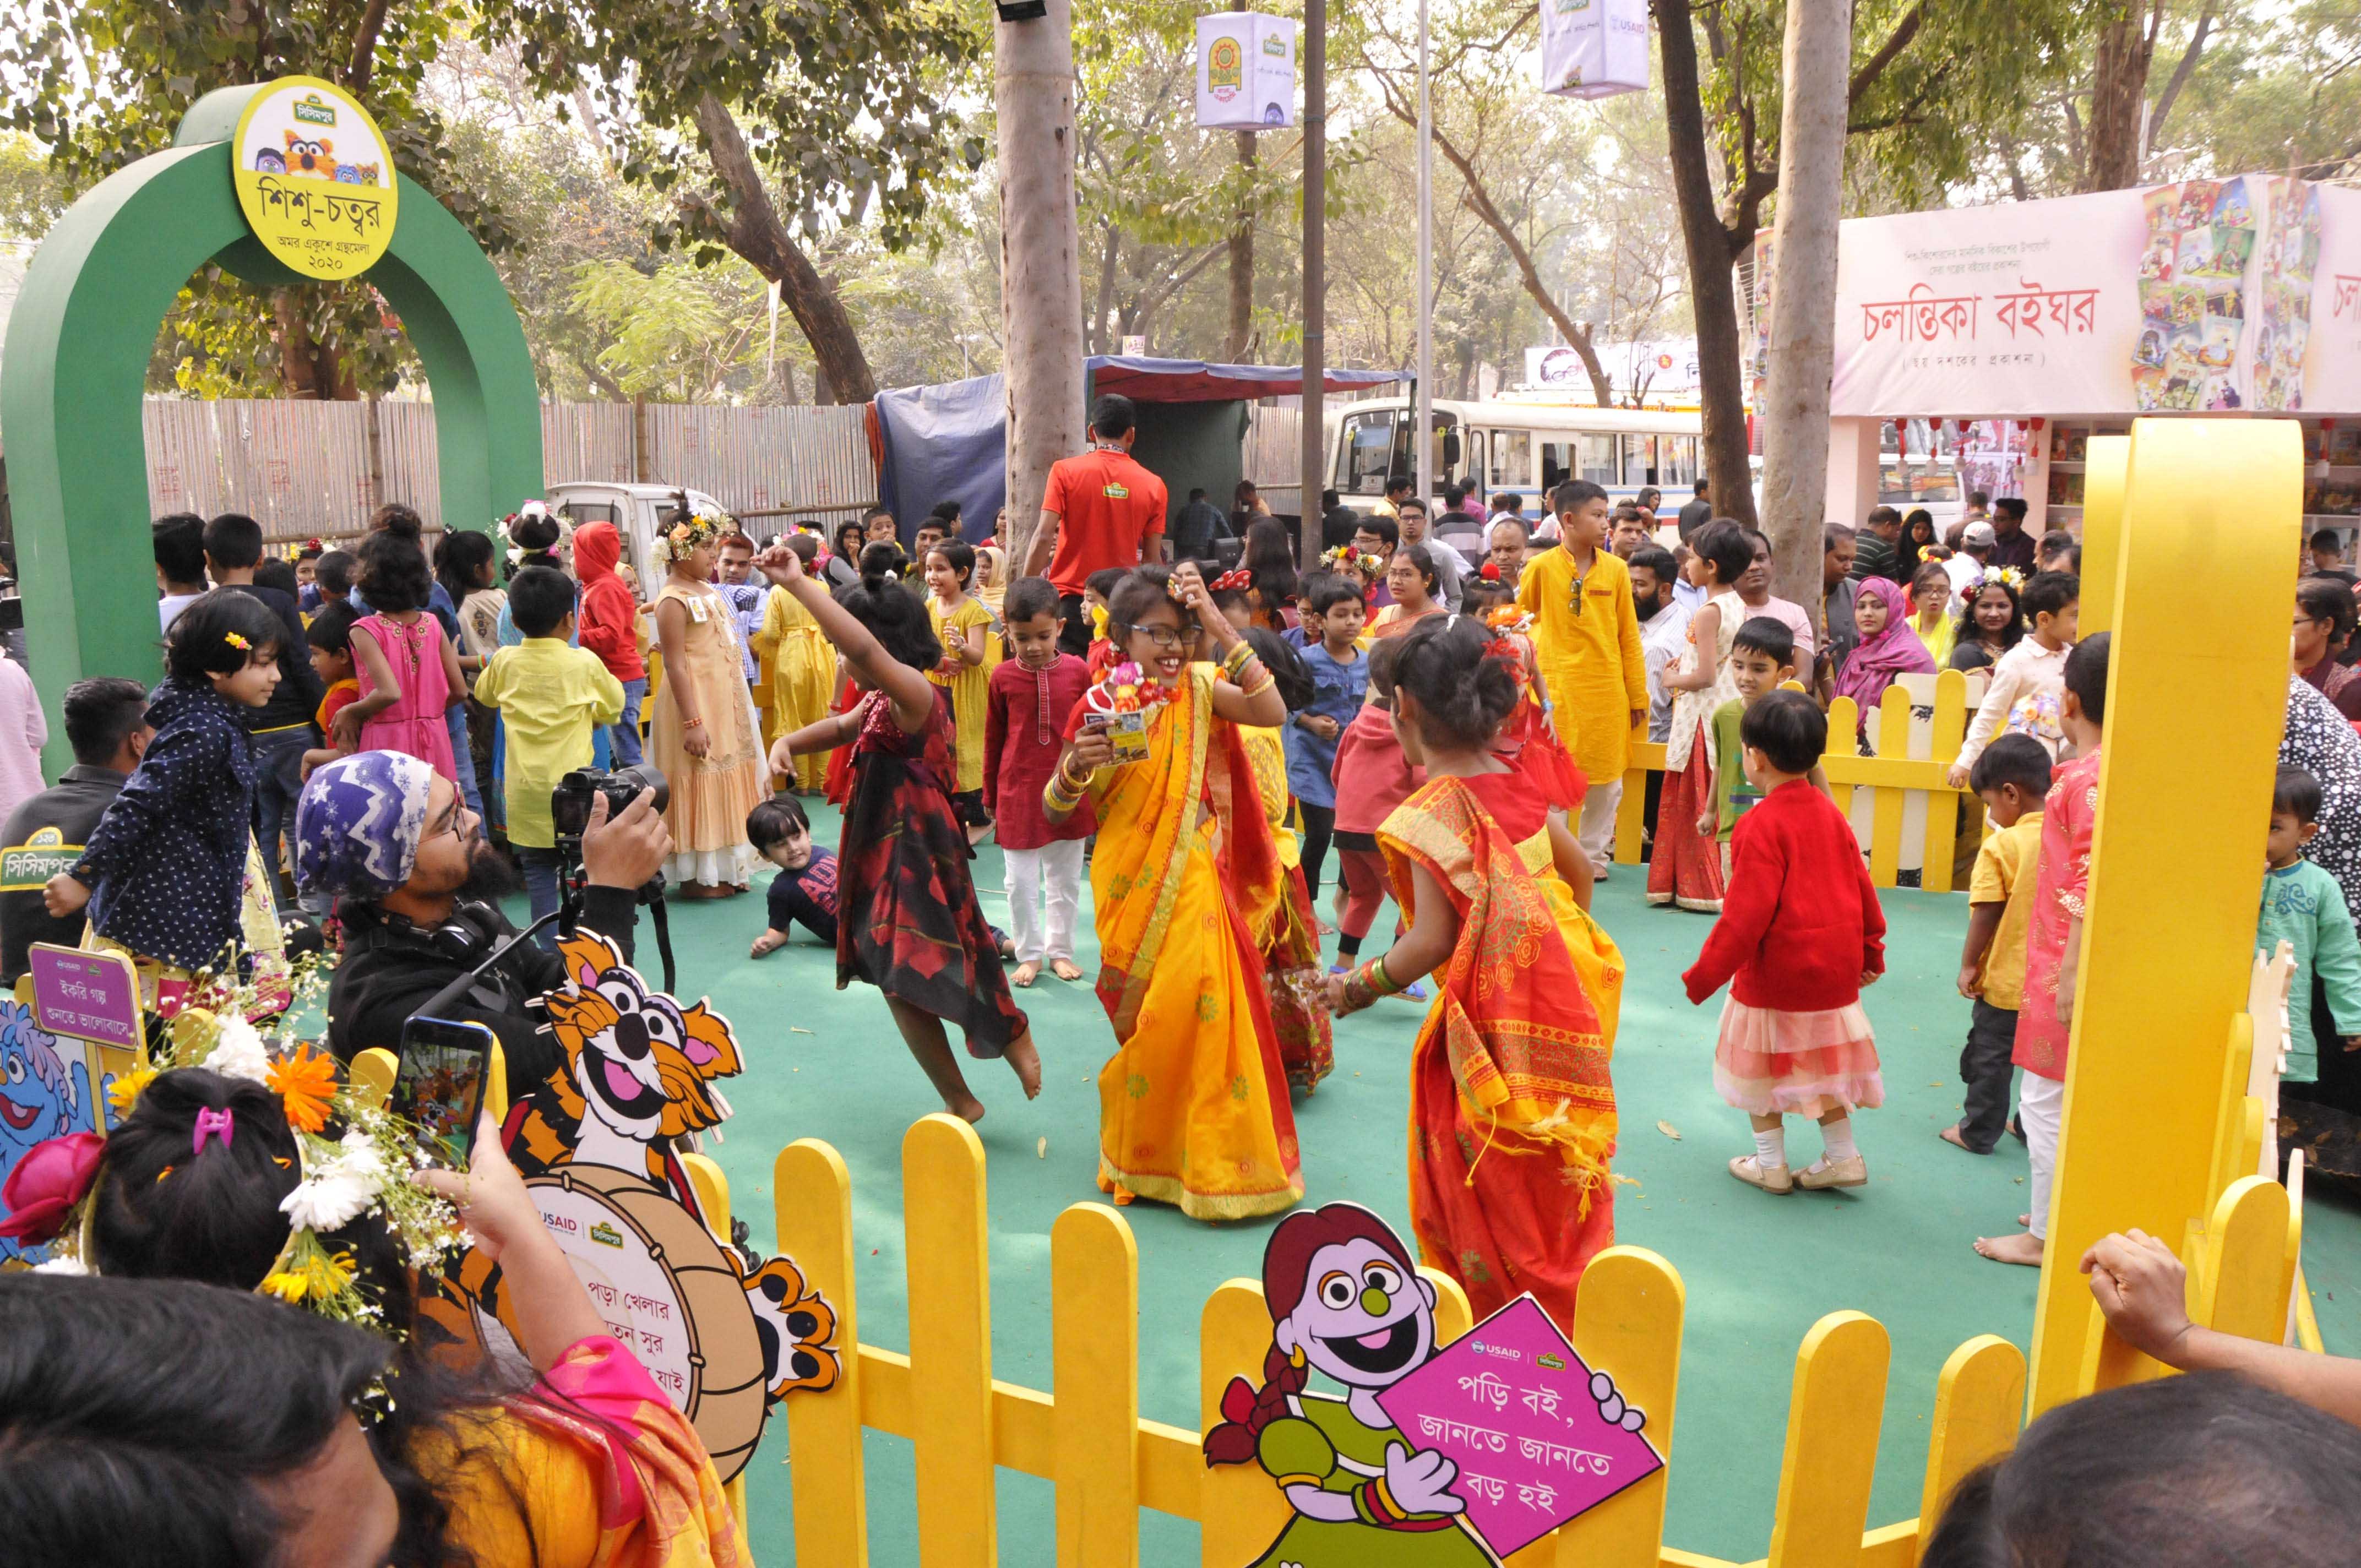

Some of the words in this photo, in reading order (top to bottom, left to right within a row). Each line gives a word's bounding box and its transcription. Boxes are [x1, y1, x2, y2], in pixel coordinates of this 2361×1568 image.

[1620, 20, 1645, 34] USAID
[297, 104, 333, 123] সিসিমপুর
[257, 176, 381, 237] শিশু-চত্বর
[278, 236, 300, 248] অমর
[304, 239, 333, 254] একুশে
[335, 242, 369, 255] গ্রন্থমেলা
[309, 255, 343, 271] ২০২০
[1860, 282, 1982, 342] চলন্তিকা
[1994, 276, 2101, 339] বইঘর
[6, 853, 78, 878] সিসিমপ
[59, 978, 87, 1000] ইকরি
[90, 988, 106, 1005] গল্প
[46, 1007, 75, 1024] শুনতে
[78, 1013, 128, 1036] ভালোবাসে
[588, 1282, 618, 1306] পড়া
[624, 1293, 670, 1321] খেলার
[639, 1330, 664, 1357] সুর
[1487, 1344, 1521, 1359] USAID
[656, 1368, 685, 1395] যাই
[1458, 1372, 1512, 1412] পড়ি
[1417, 1413, 1510, 1453] জানতে
[1517, 1436, 1614, 1476] জানতে
[1464, 1471, 1508, 1506] বড়
[1515, 1479, 1559, 1516] হই
